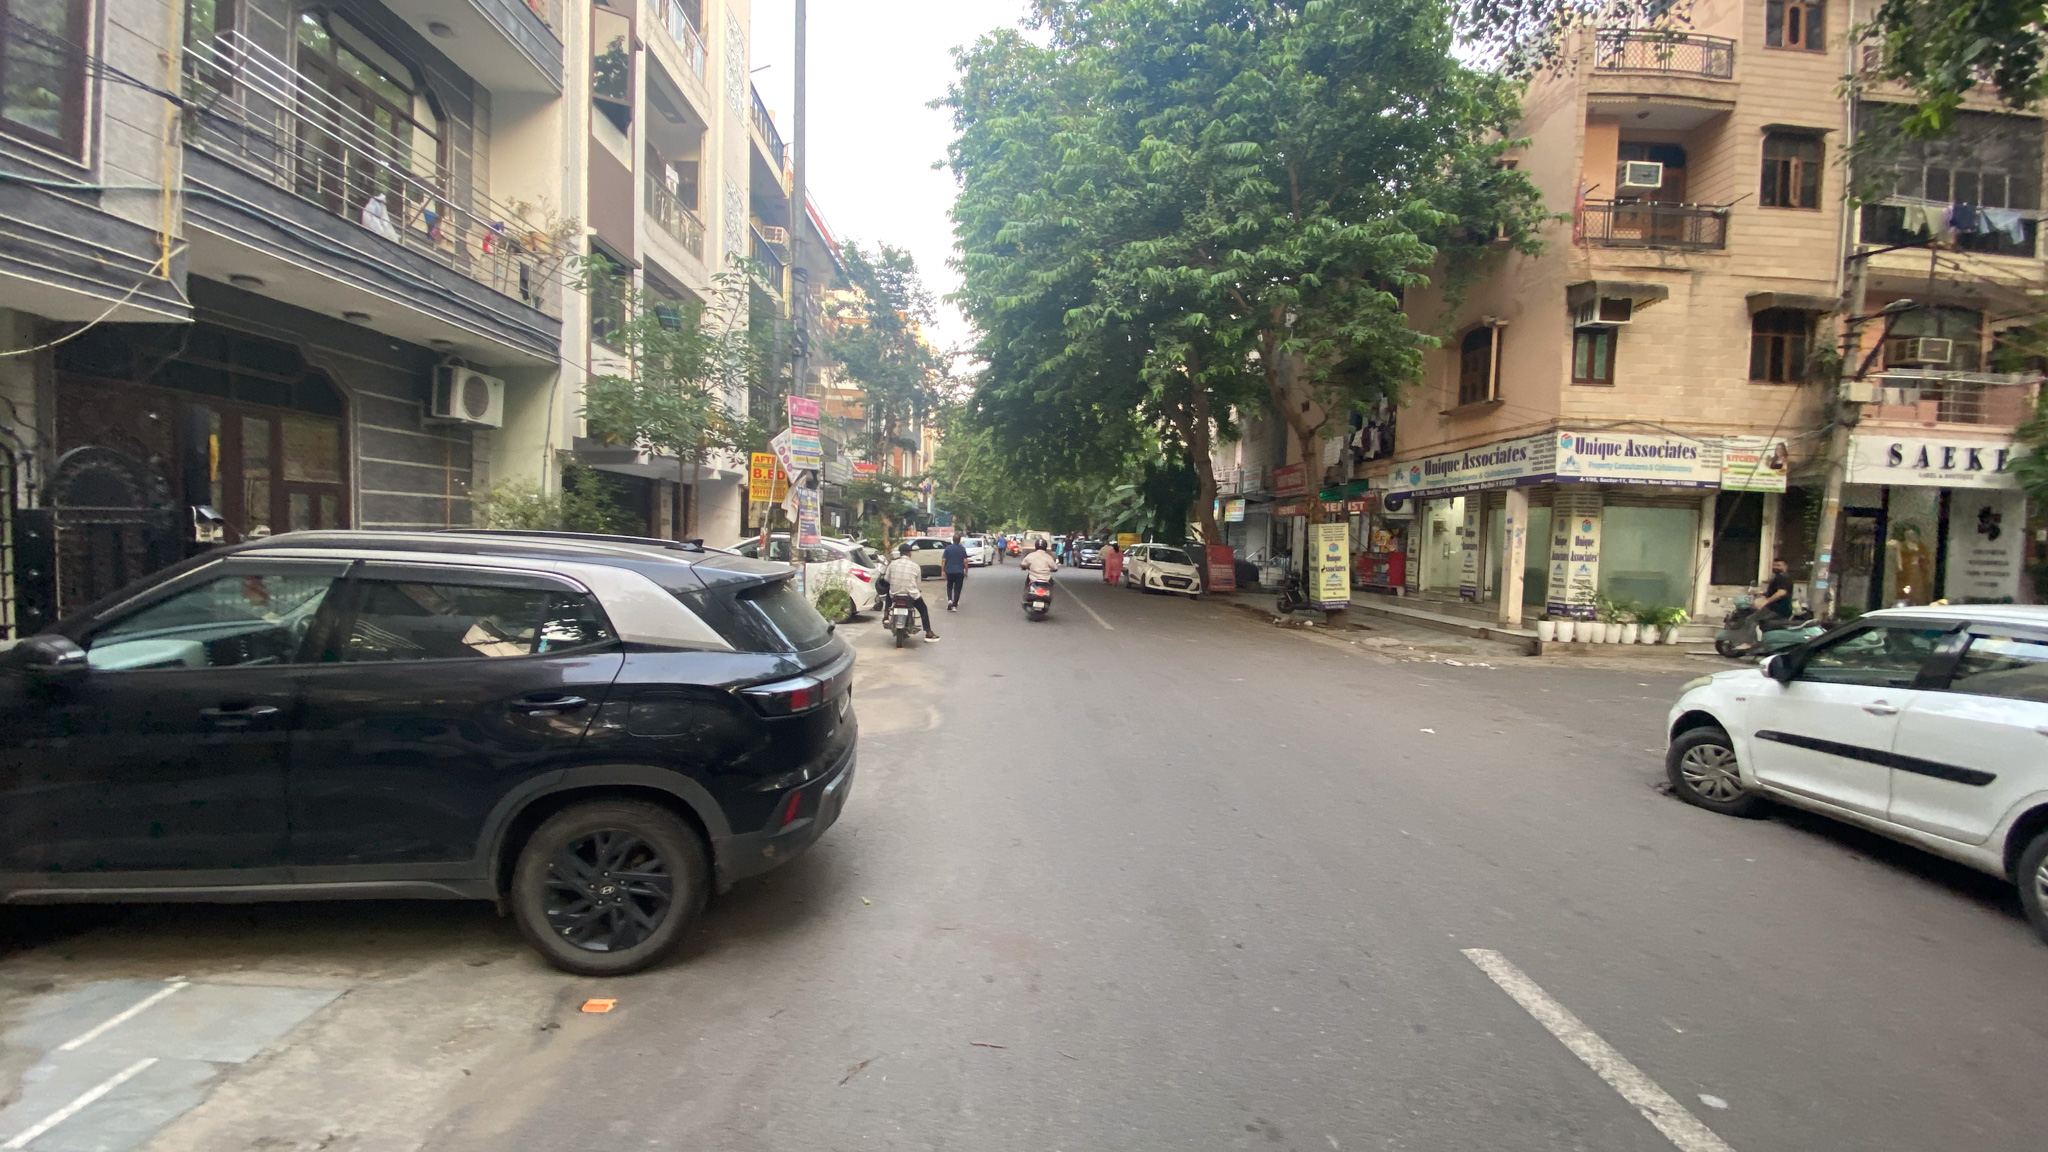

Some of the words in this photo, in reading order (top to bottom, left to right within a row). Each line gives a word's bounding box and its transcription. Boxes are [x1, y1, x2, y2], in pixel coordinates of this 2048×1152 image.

[1574, 436, 1622, 460] Unique
[1624, 439, 1697, 460] Associates
[754, 455, 777, 465] AFTE
[1424, 457, 1460, 477] Unique
[1462, 445, 1527, 470] Associates
[1588, 461, 1613, 471] Property
[1575, 535, 1595, 550] Unique
[1570, 551, 1598, 562] Associates
